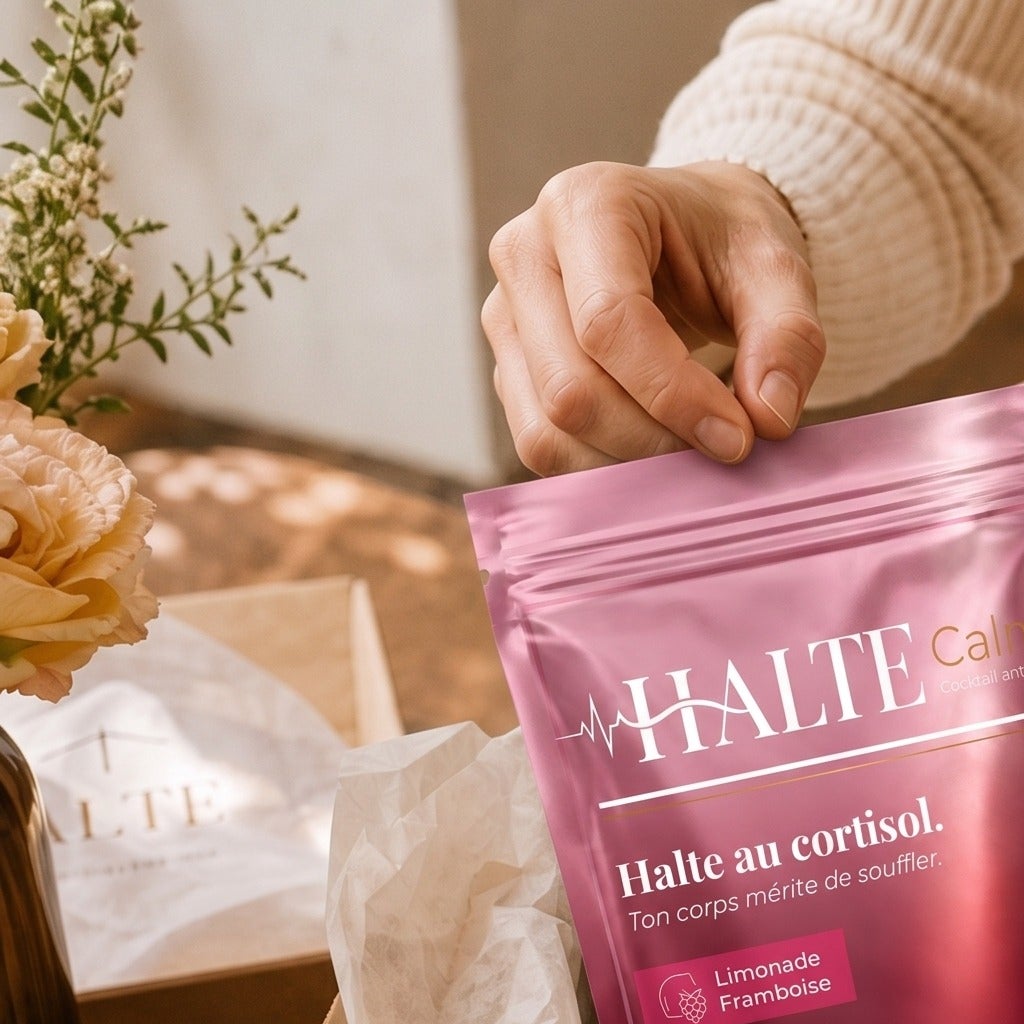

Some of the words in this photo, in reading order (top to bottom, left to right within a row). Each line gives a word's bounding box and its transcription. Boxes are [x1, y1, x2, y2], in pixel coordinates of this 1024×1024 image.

[621, 622, 926, 764] HALTE
[616, 848, 725, 898] Halte
[734, 840, 783, 874] au
[790, 795, 945, 863] cortisol.
[627, 909, 670, 933] Ton
[675, 893, 740, 927] corps
[745, 875, 819, 907] mérite
[824, 867, 853, 891] de
[857, 847, 943, 884] souffler.
[714, 949, 821, 988] Limonade
[719, 974, 833, 1014] Framboise
